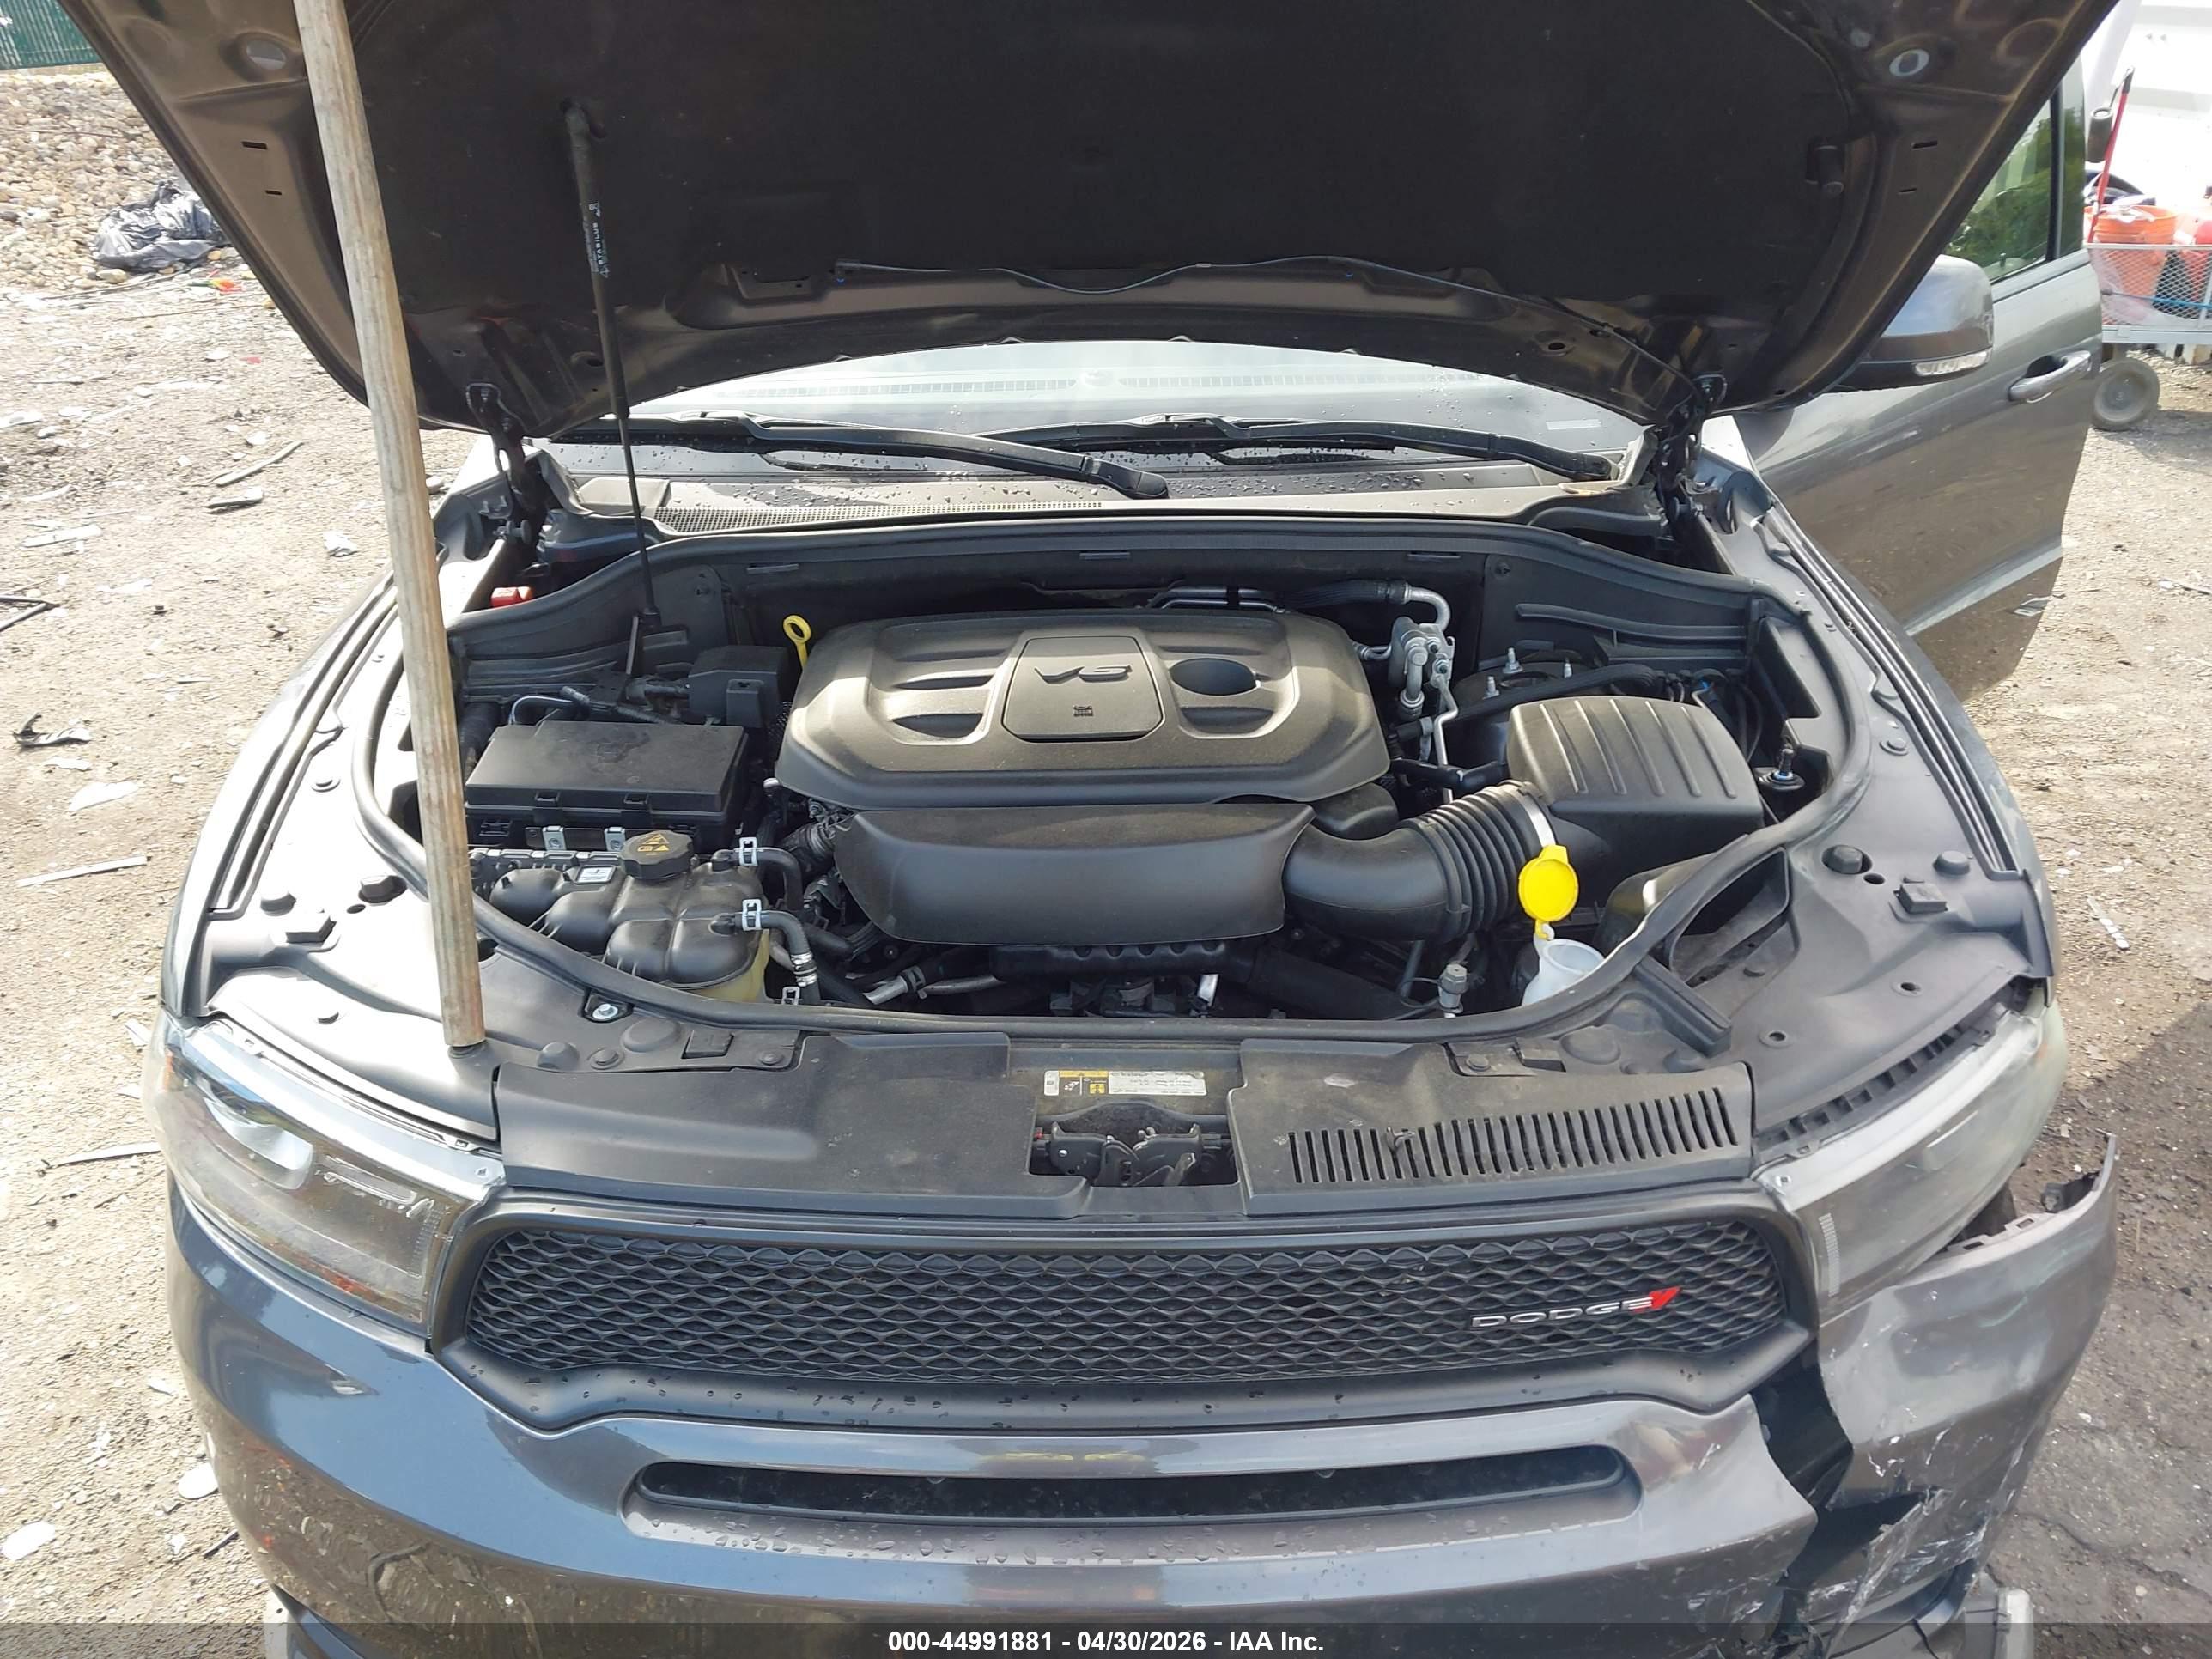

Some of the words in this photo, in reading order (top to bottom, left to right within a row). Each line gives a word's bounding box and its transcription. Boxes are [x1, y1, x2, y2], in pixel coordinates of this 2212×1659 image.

[592, 222, 604, 265] STABILUS
[1033, 665, 1133, 684] V6
[1471, 1297, 1653, 1328] DODGE
